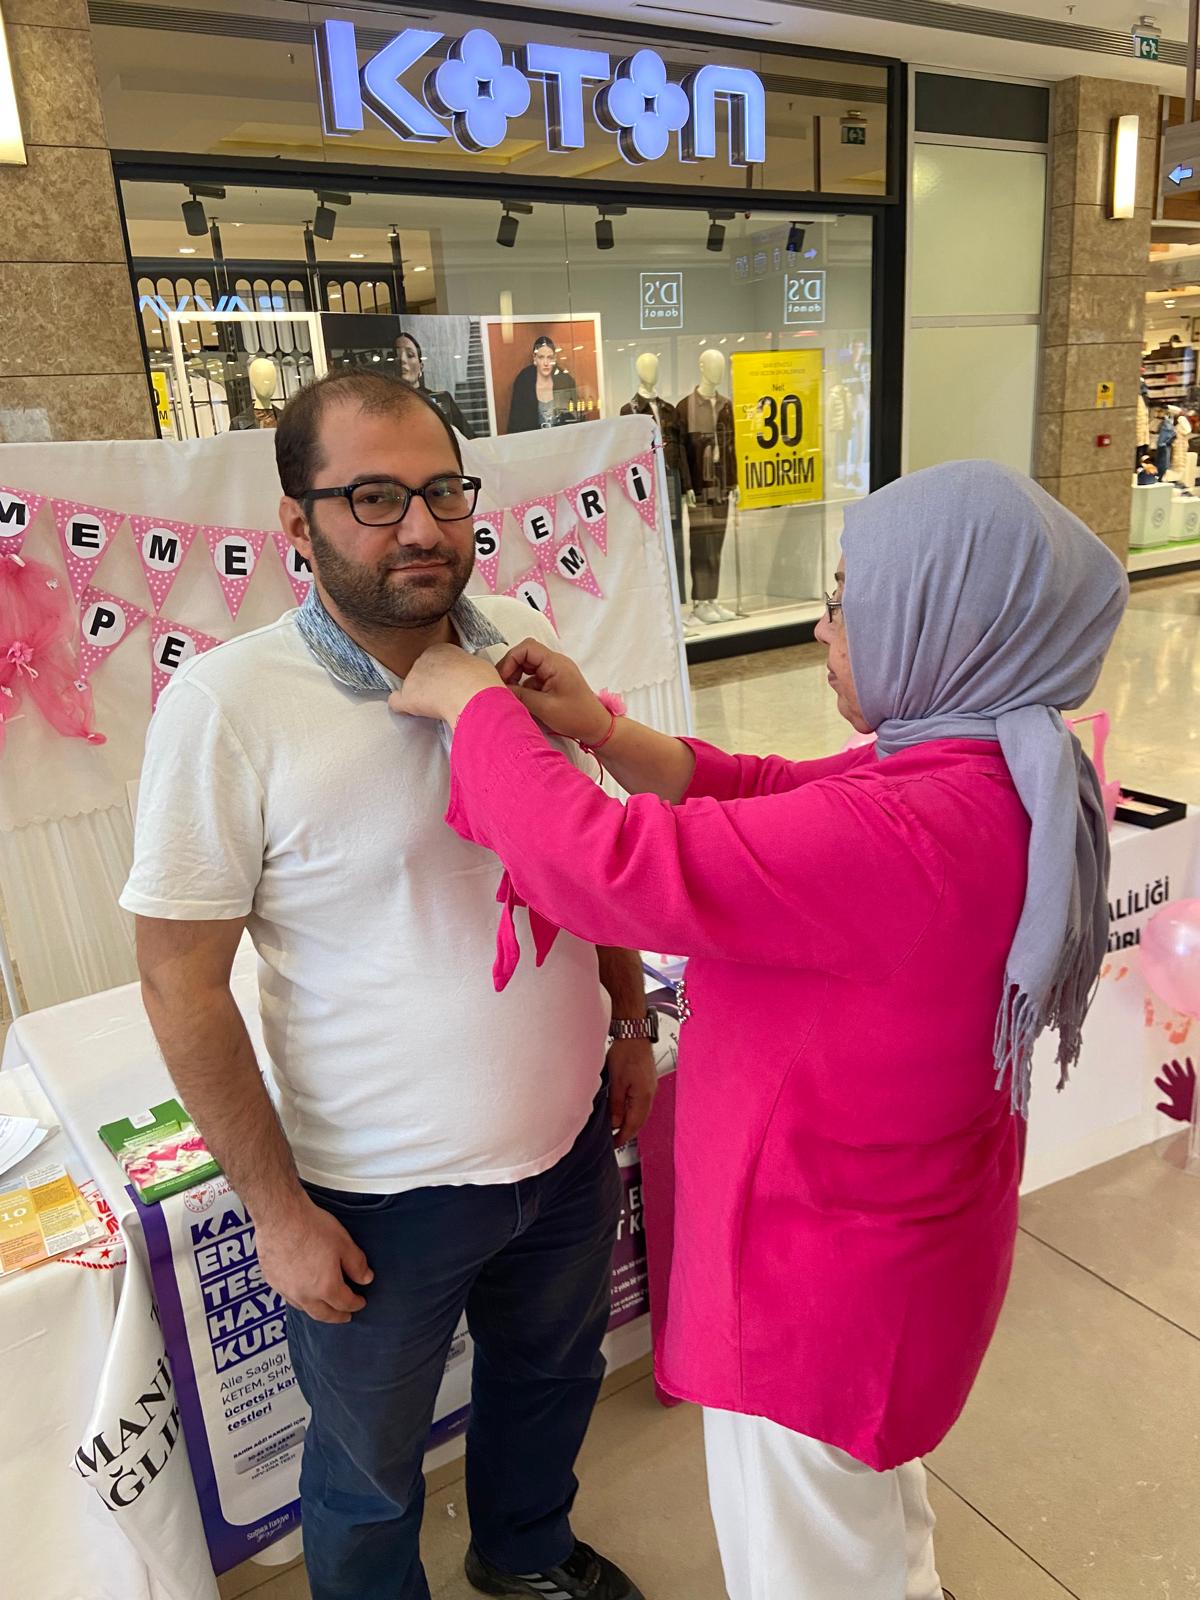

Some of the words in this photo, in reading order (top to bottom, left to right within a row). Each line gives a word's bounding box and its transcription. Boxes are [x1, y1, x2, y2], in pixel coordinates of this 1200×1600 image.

[757, 394, 803, 449] 30
[745, 451, 814, 489] İNDİRİM
[214, 1315, 287, 1370] KUR
[220, 1375, 243, 1392] Aile
[222, 1379, 266, 1405] KETEM,
[225, 1386, 275, 1419] ücretsiz
[228, 1401, 273, 1432] testleri
